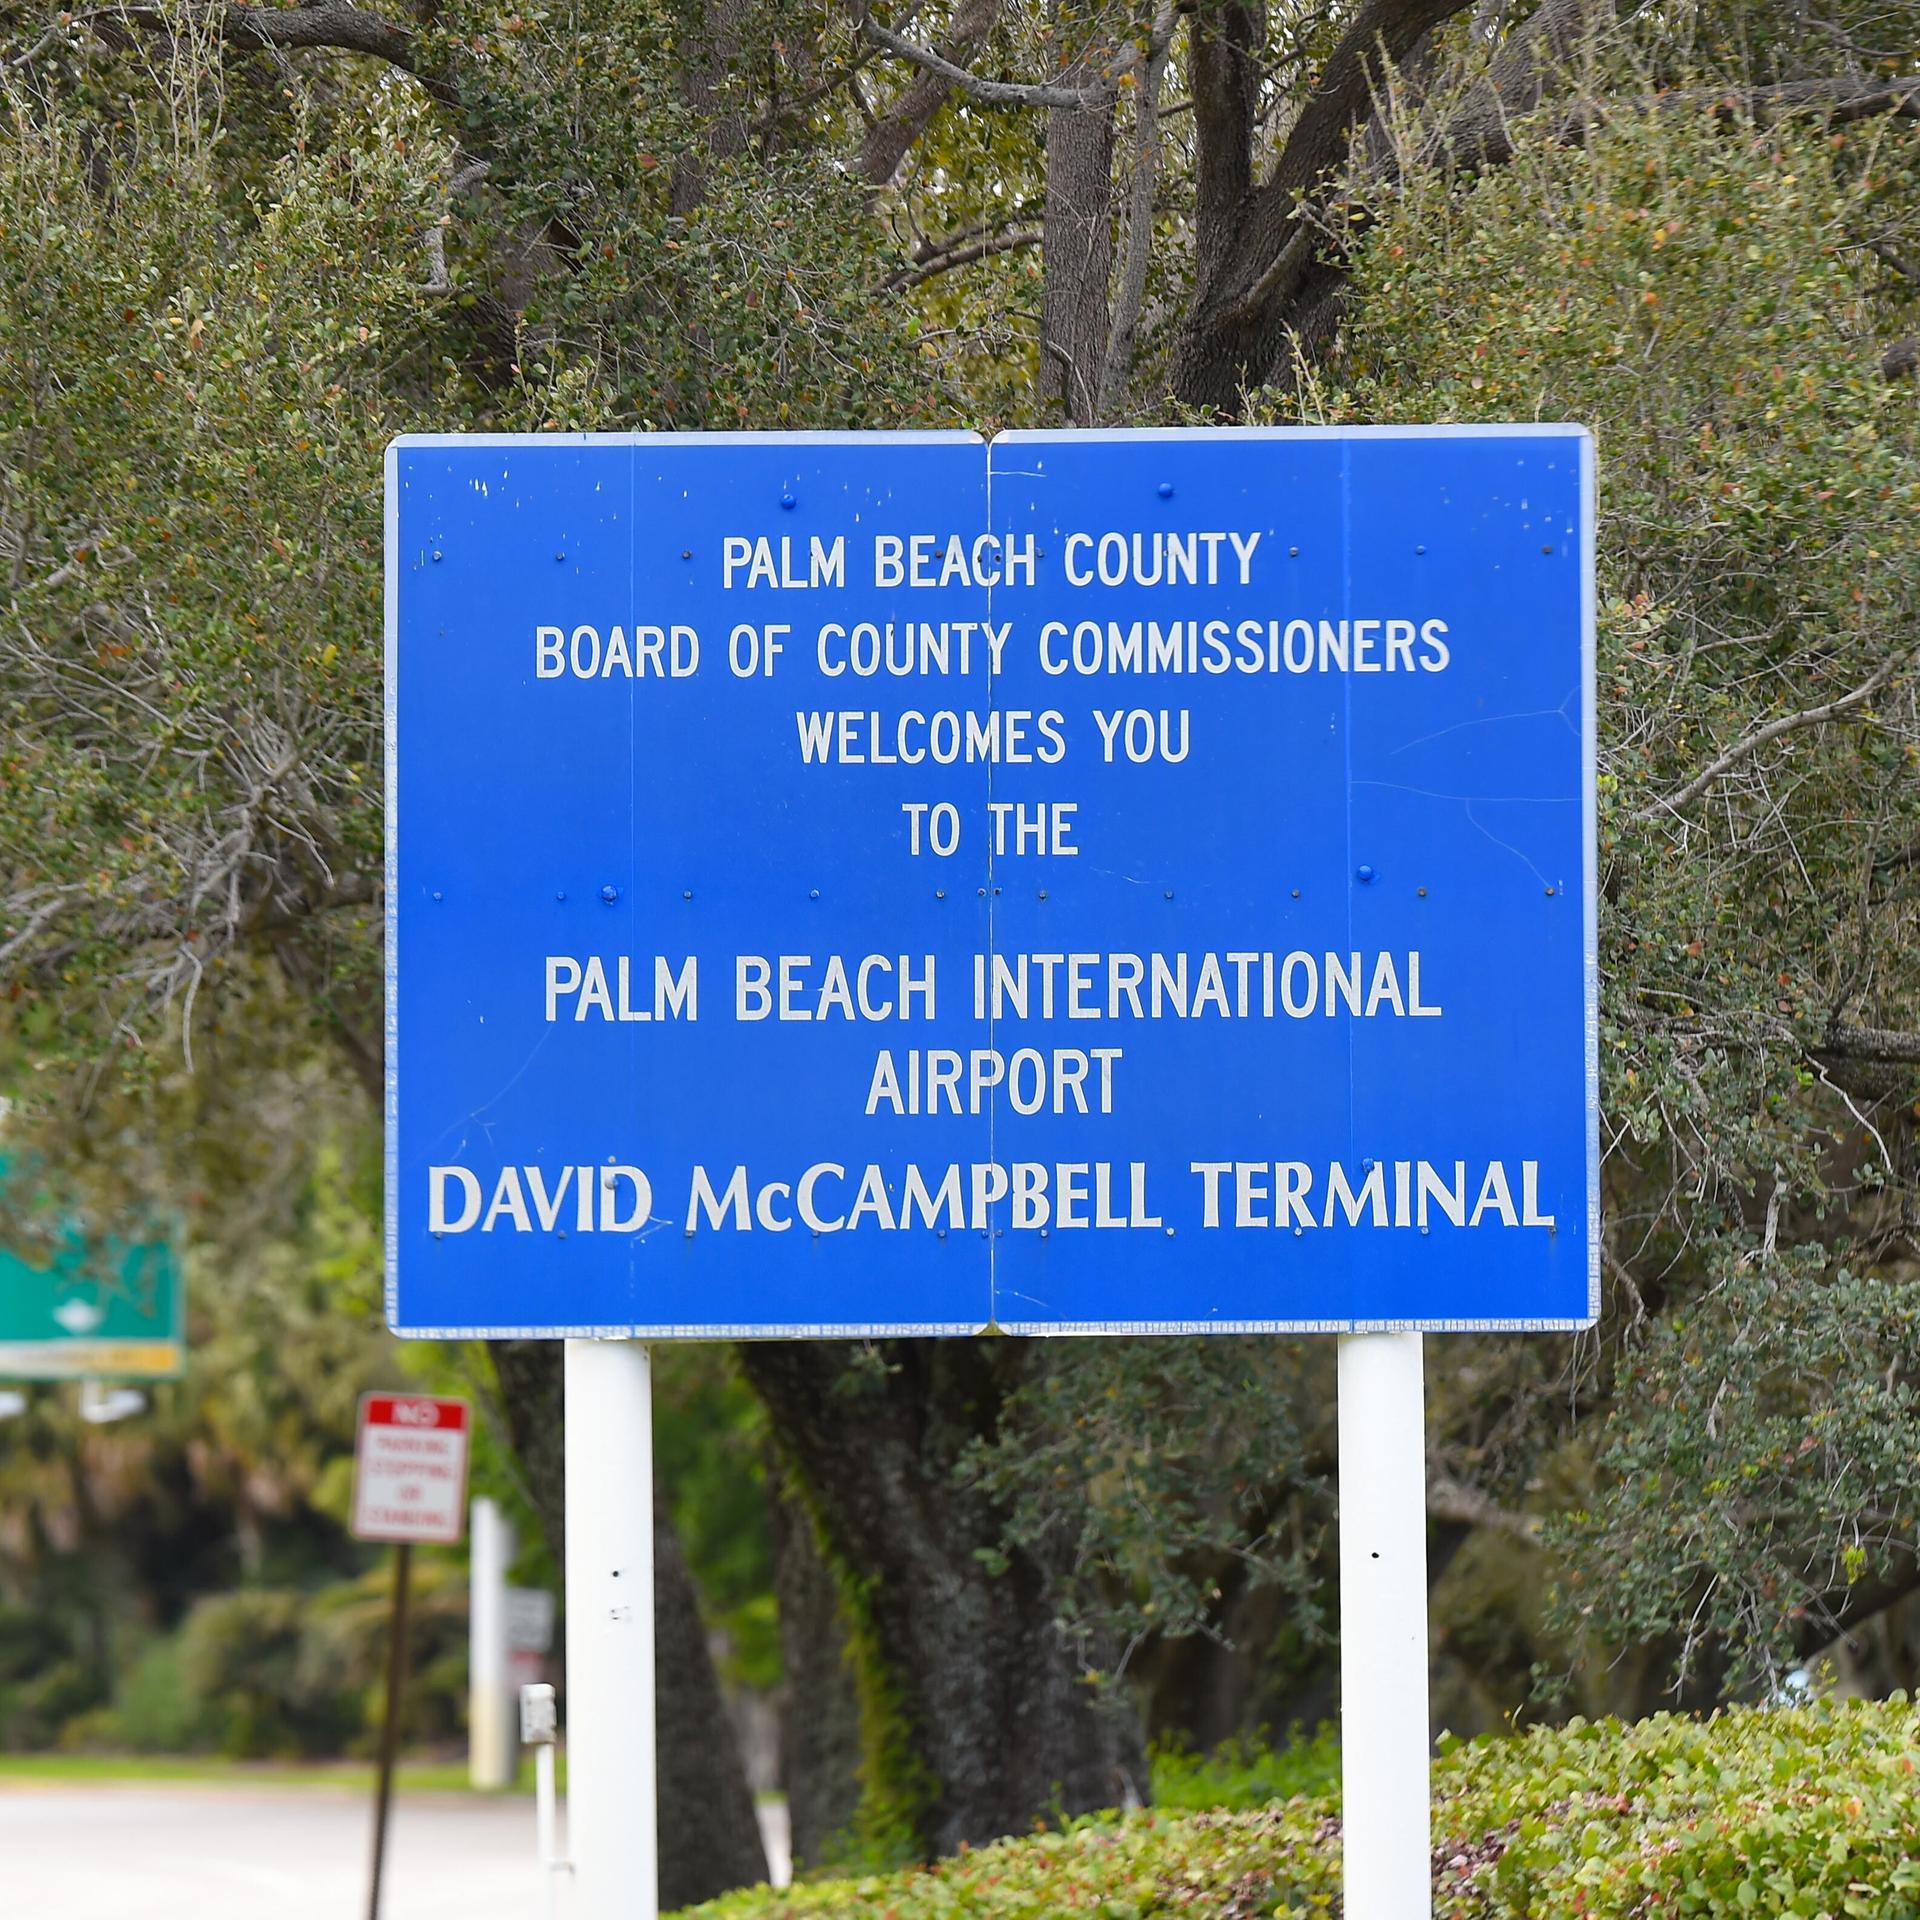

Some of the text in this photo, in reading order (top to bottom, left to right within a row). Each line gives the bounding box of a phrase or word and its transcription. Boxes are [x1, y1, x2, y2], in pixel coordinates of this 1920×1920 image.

[723, 532, 1262, 589] PALM BEACH COUNTY
[536, 619, 1451, 679] BOARD OF COUNTY COMMISSIONERS
[796, 709, 1190, 765] WELCOMES YOU
[902, 803, 1079, 857] TO THE
[545, 951, 1442, 1022] PALM BEACH INTERNATIONAL
[865, 1048, 1123, 1115] AIRPORT
[428, 1160, 1556, 1233] DAVID McCAMPBELL TERMINAL
[391, 1401, 440, 1426] NO
